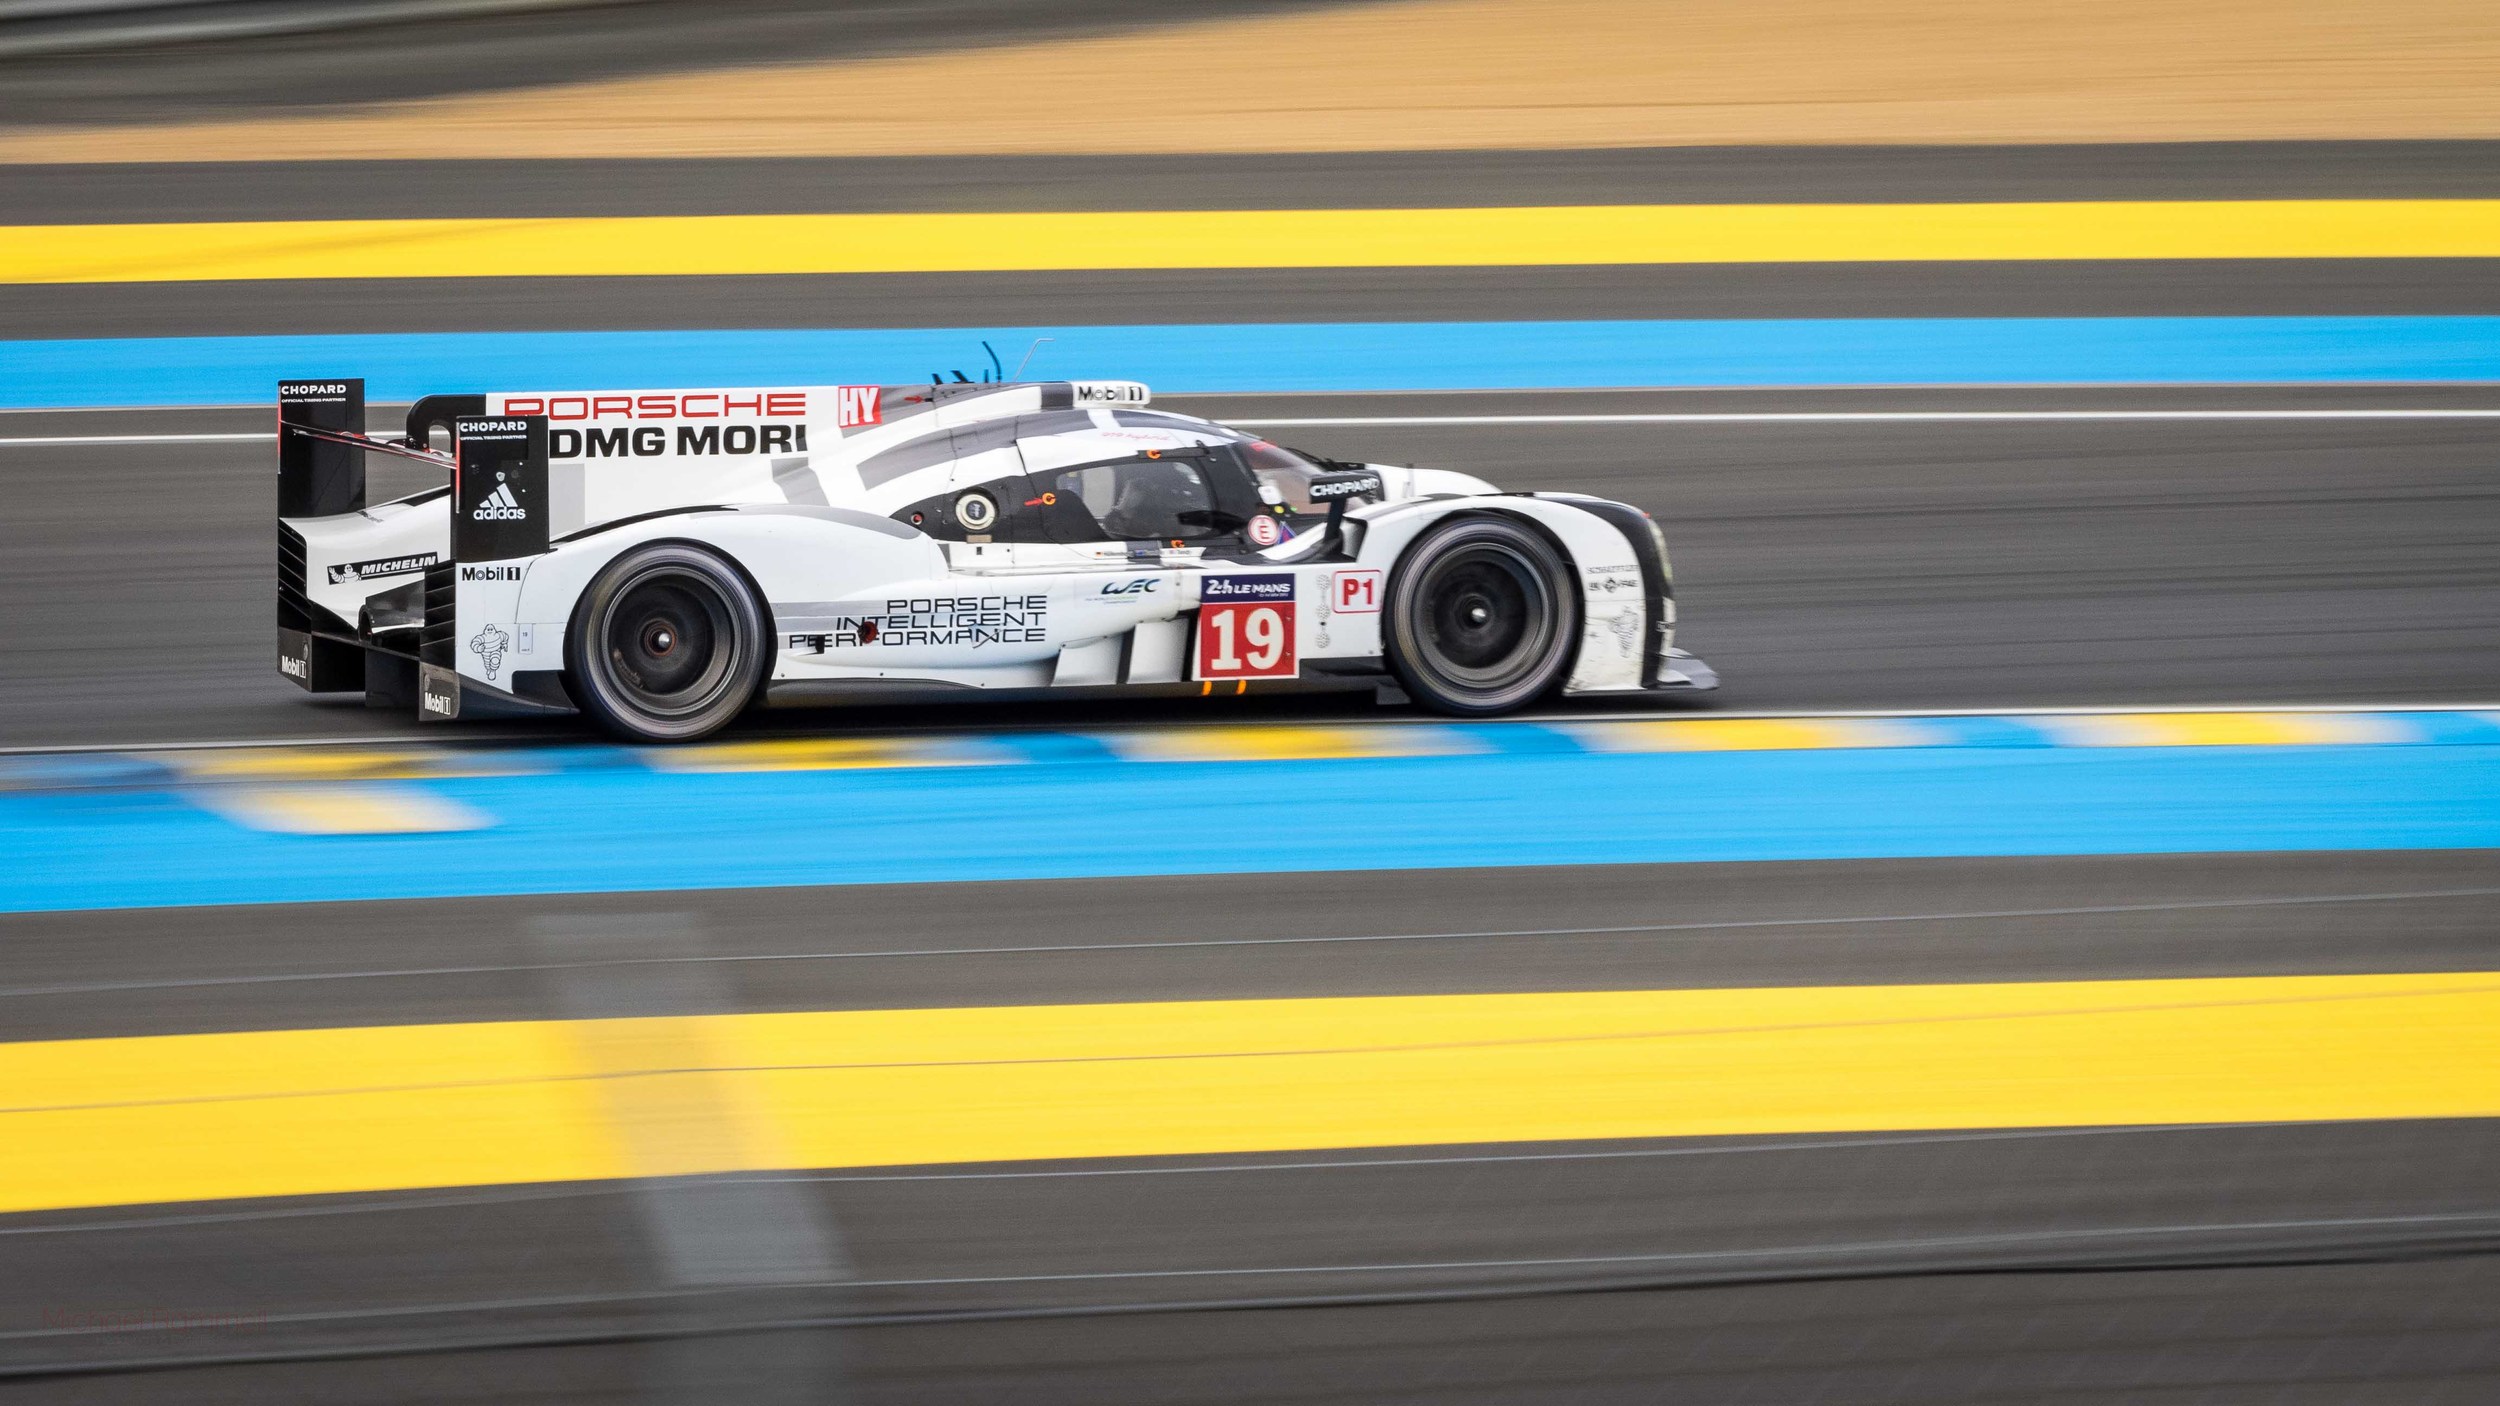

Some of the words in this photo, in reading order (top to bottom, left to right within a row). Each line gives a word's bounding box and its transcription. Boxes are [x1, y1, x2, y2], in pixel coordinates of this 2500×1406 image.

[281, 384, 347, 395] CHOPARD
[1078, 386, 1125, 401] Mobil
[504, 393, 806, 420] PORSCHE
[839, 387, 879, 426] HY
[460, 421, 527, 432] CHOPARD
[549, 427, 666, 458] DMG
[677, 424, 808, 456] MORI
[1309, 477, 1381, 497] CHOPARD
[473, 507, 526, 520] adidas
[1259, 525, 1270, 540] E
[361, 555, 437, 575] MICHELIN
[461, 567, 504, 581] Mobil
[507, 567, 520, 581] 1
[1101, 578, 1161, 595] WEC
[1234, 584, 1252, 594] LE
[1251, 583, 1291, 593] MANS
[1343, 578, 1374, 606] P1
[887, 595, 1048, 614] PORSCHE
[836, 612, 1047, 630] INTELLIGENT
[1211, 607, 1286, 671] 19
[281, 655, 300, 677] Mobil
[300, 660, 307, 679] 1
[424, 691, 444, 714] Mobil
[444, 697, 451, 715] 1
